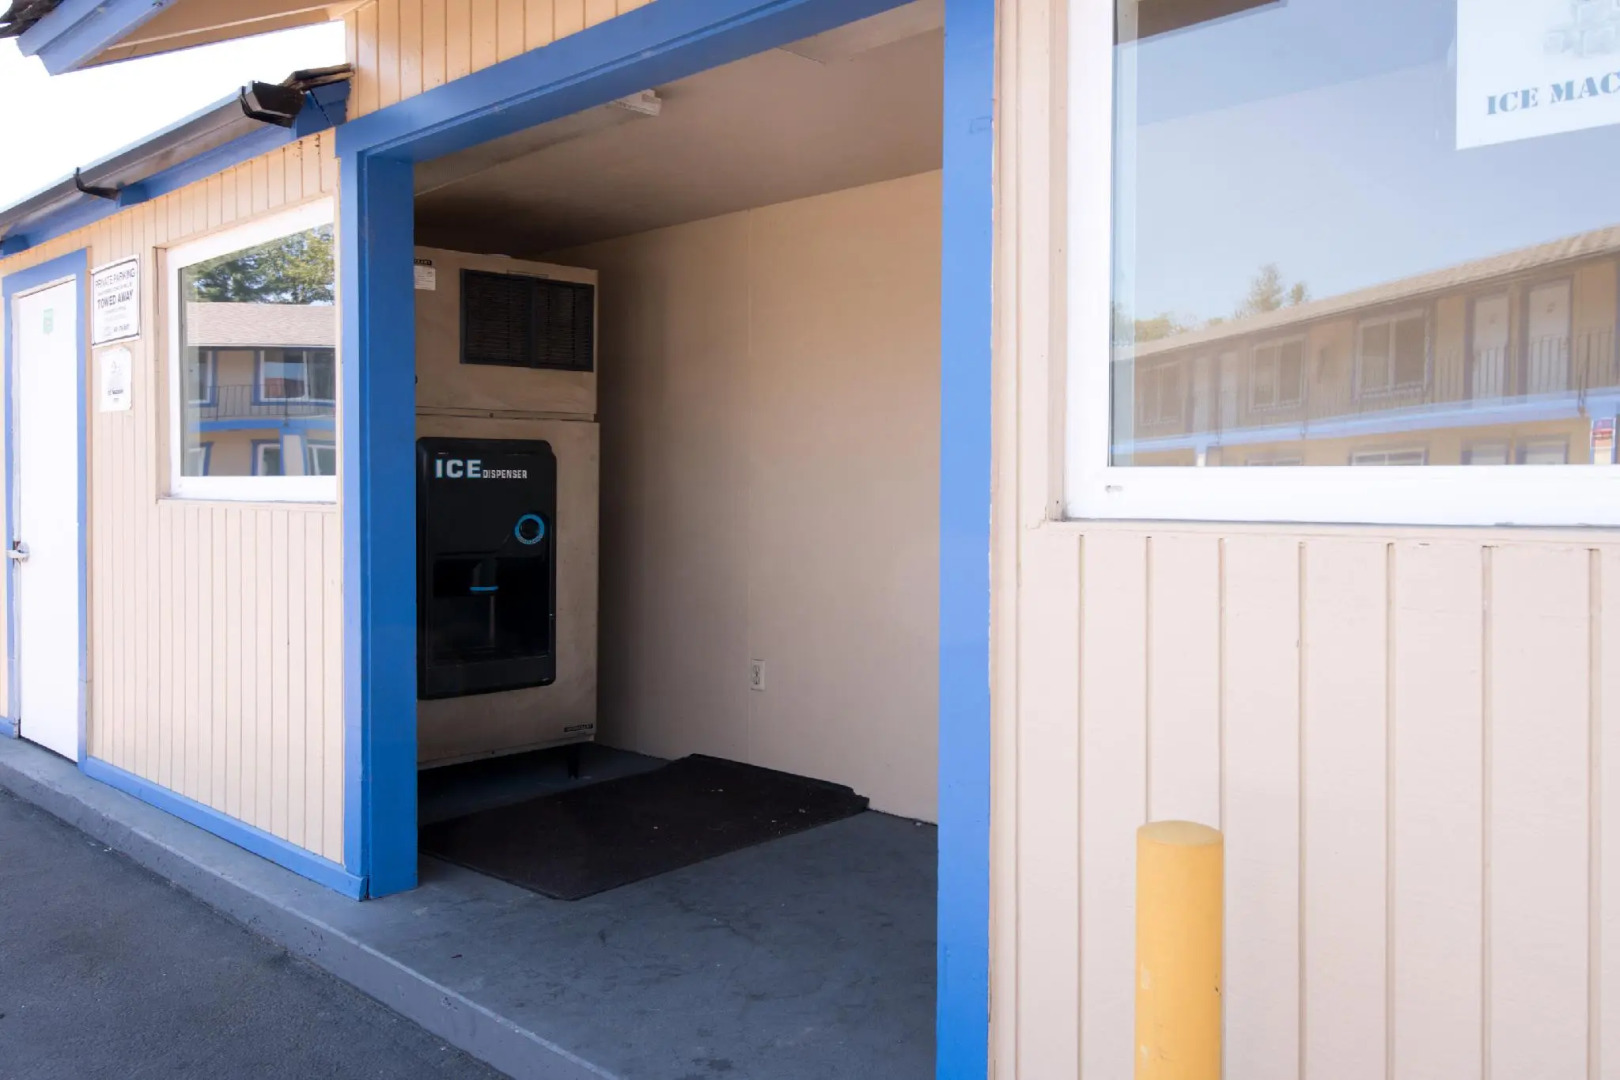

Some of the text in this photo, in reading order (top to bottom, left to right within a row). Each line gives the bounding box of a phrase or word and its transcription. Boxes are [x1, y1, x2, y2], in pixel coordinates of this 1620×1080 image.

[1487, 71, 1620, 115] ICE MAC
[95, 267, 135, 288] PRIVATE PARKING
[97, 295, 116, 309] TOWED
[117, 289, 134, 303] AWAY
[435, 459, 528, 479] ICE DISPENSER
